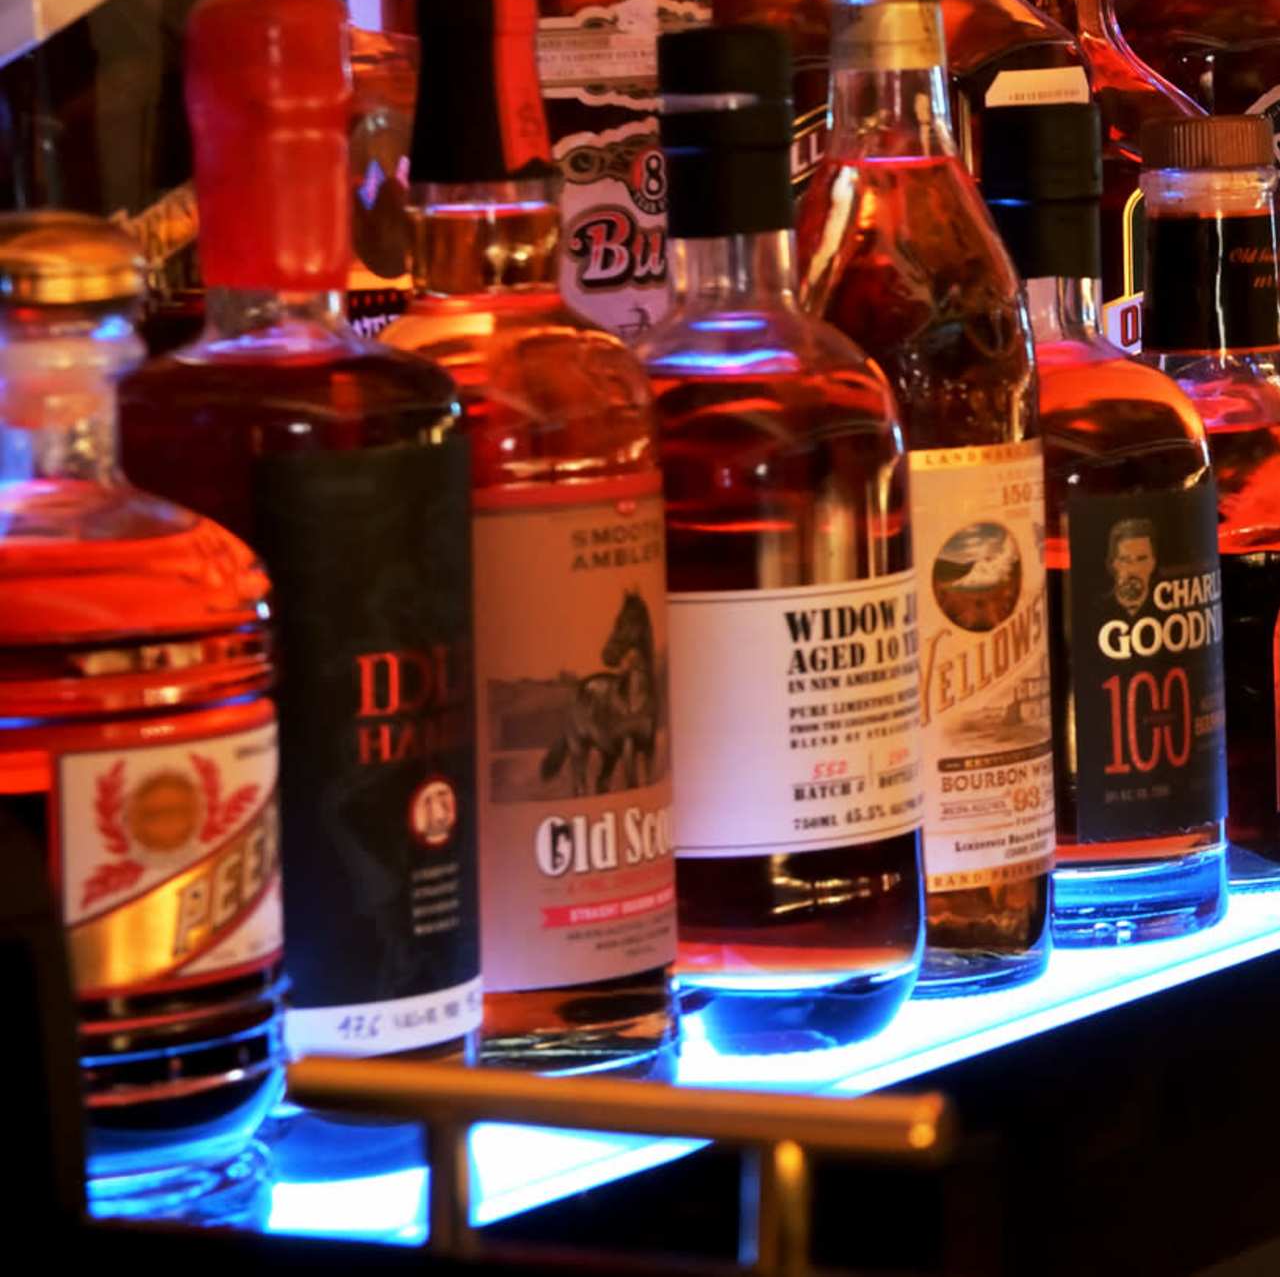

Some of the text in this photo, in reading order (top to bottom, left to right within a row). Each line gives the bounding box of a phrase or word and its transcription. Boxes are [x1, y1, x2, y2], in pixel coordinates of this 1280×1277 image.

[649, 153, 665, 197] 8
[784, 598, 898, 644] WIDOW
[787, 642, 866, 676] AGED
[876, 635, 899, 664] 10
[1102, 667, 1192, 776] 100
[794, 781, 851, 801] BATCH
[941, 768, 1027, 793] BOURBON
